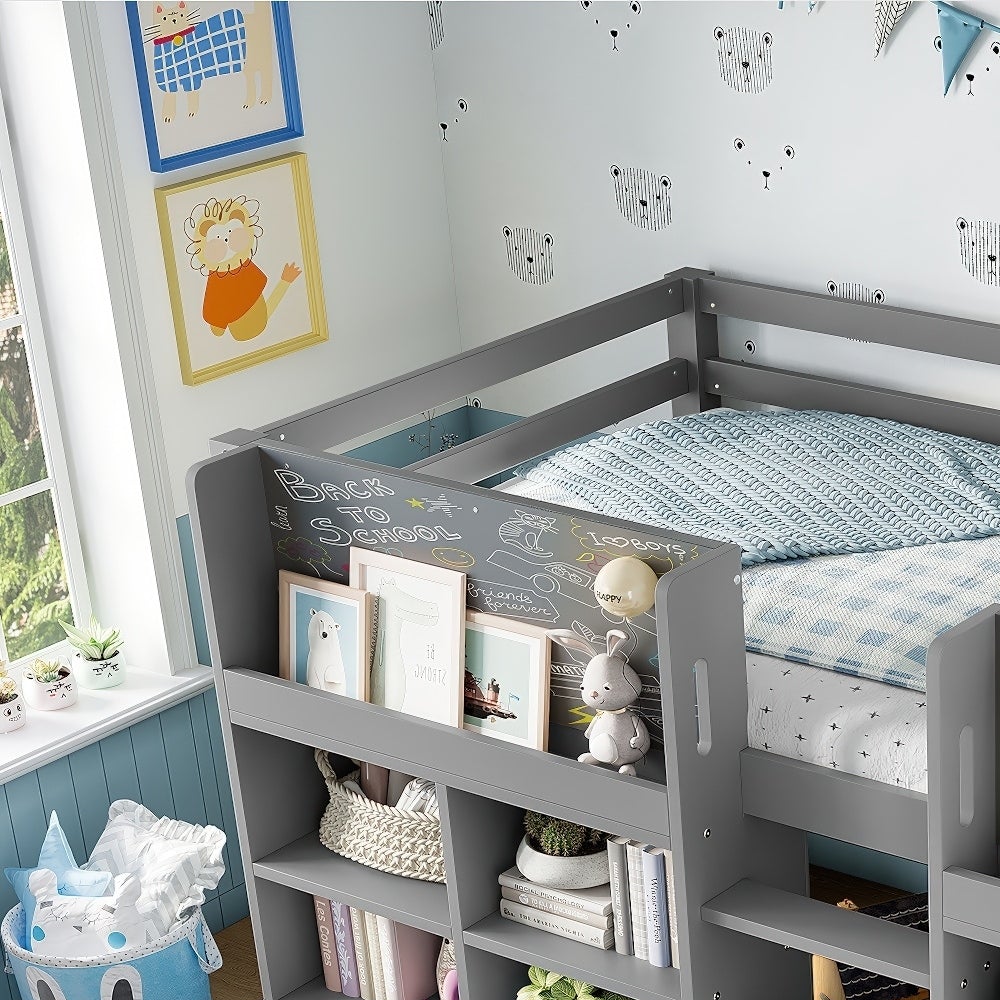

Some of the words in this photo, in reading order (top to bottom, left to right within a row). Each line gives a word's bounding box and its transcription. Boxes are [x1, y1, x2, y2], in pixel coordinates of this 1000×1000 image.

[274, 468, 395, 503] BACK
[337, 506, 391, 524] TO
[310, 517, 462, 547] SCHOOL
[628, 538, 687, 556] BOYS
[316, 900, 326, 922] Les
[320, 924, 332, 967] Contes
